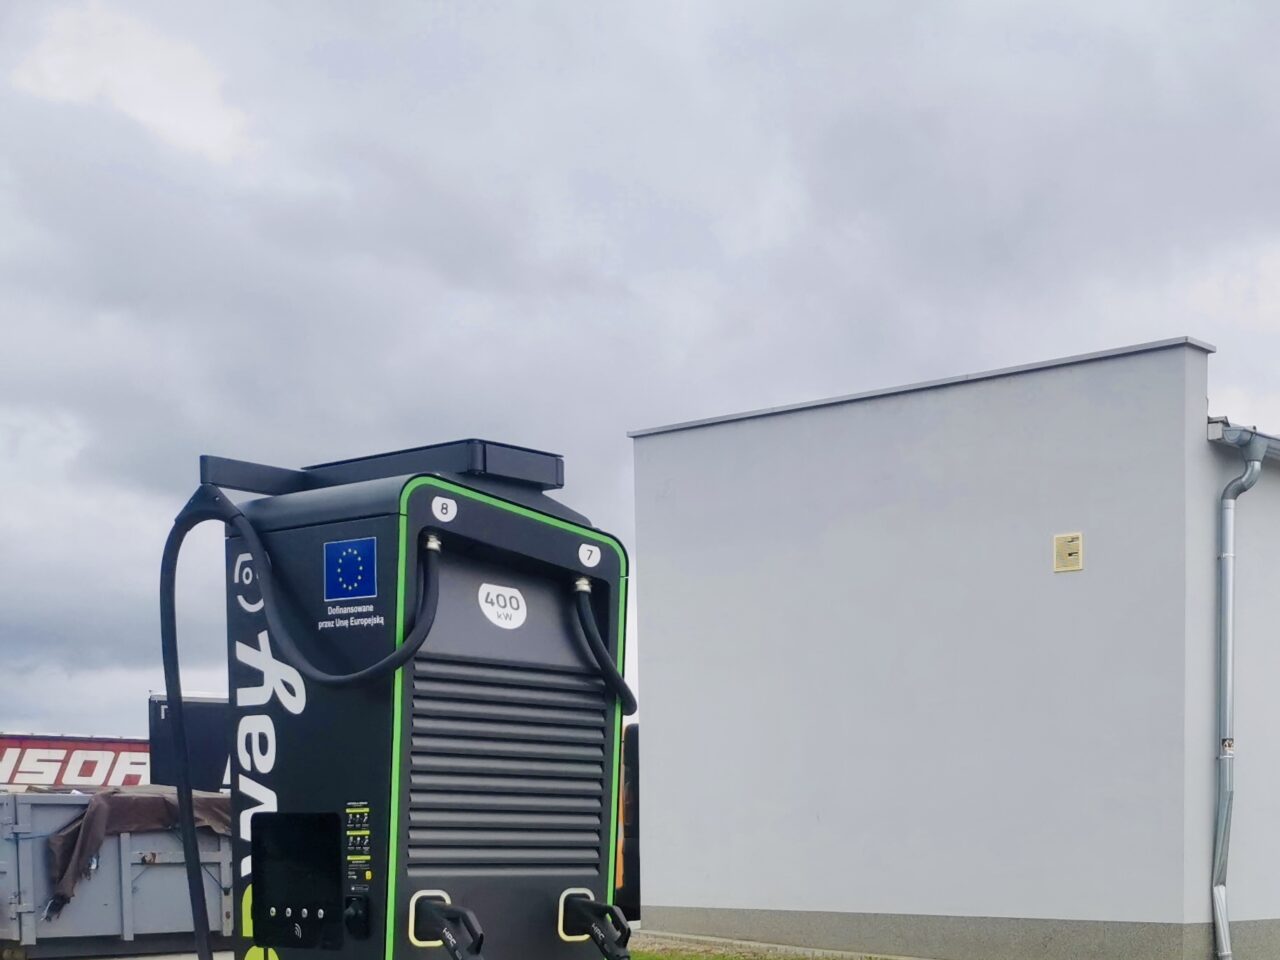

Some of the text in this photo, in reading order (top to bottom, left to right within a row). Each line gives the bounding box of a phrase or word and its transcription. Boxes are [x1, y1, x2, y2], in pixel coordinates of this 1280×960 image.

[441, 503, 448, 515] 8
[587, 549, 593, 560] 7
[485, 592, 520, 610] 400
[328, 605, 374, 615] Dofinansowane
[497, 611, 512, 621] kW
[318, 621, 335, 630] przez
[350, 615, 384, 627] Europejską
[443, 928, 456, 947] HPC
